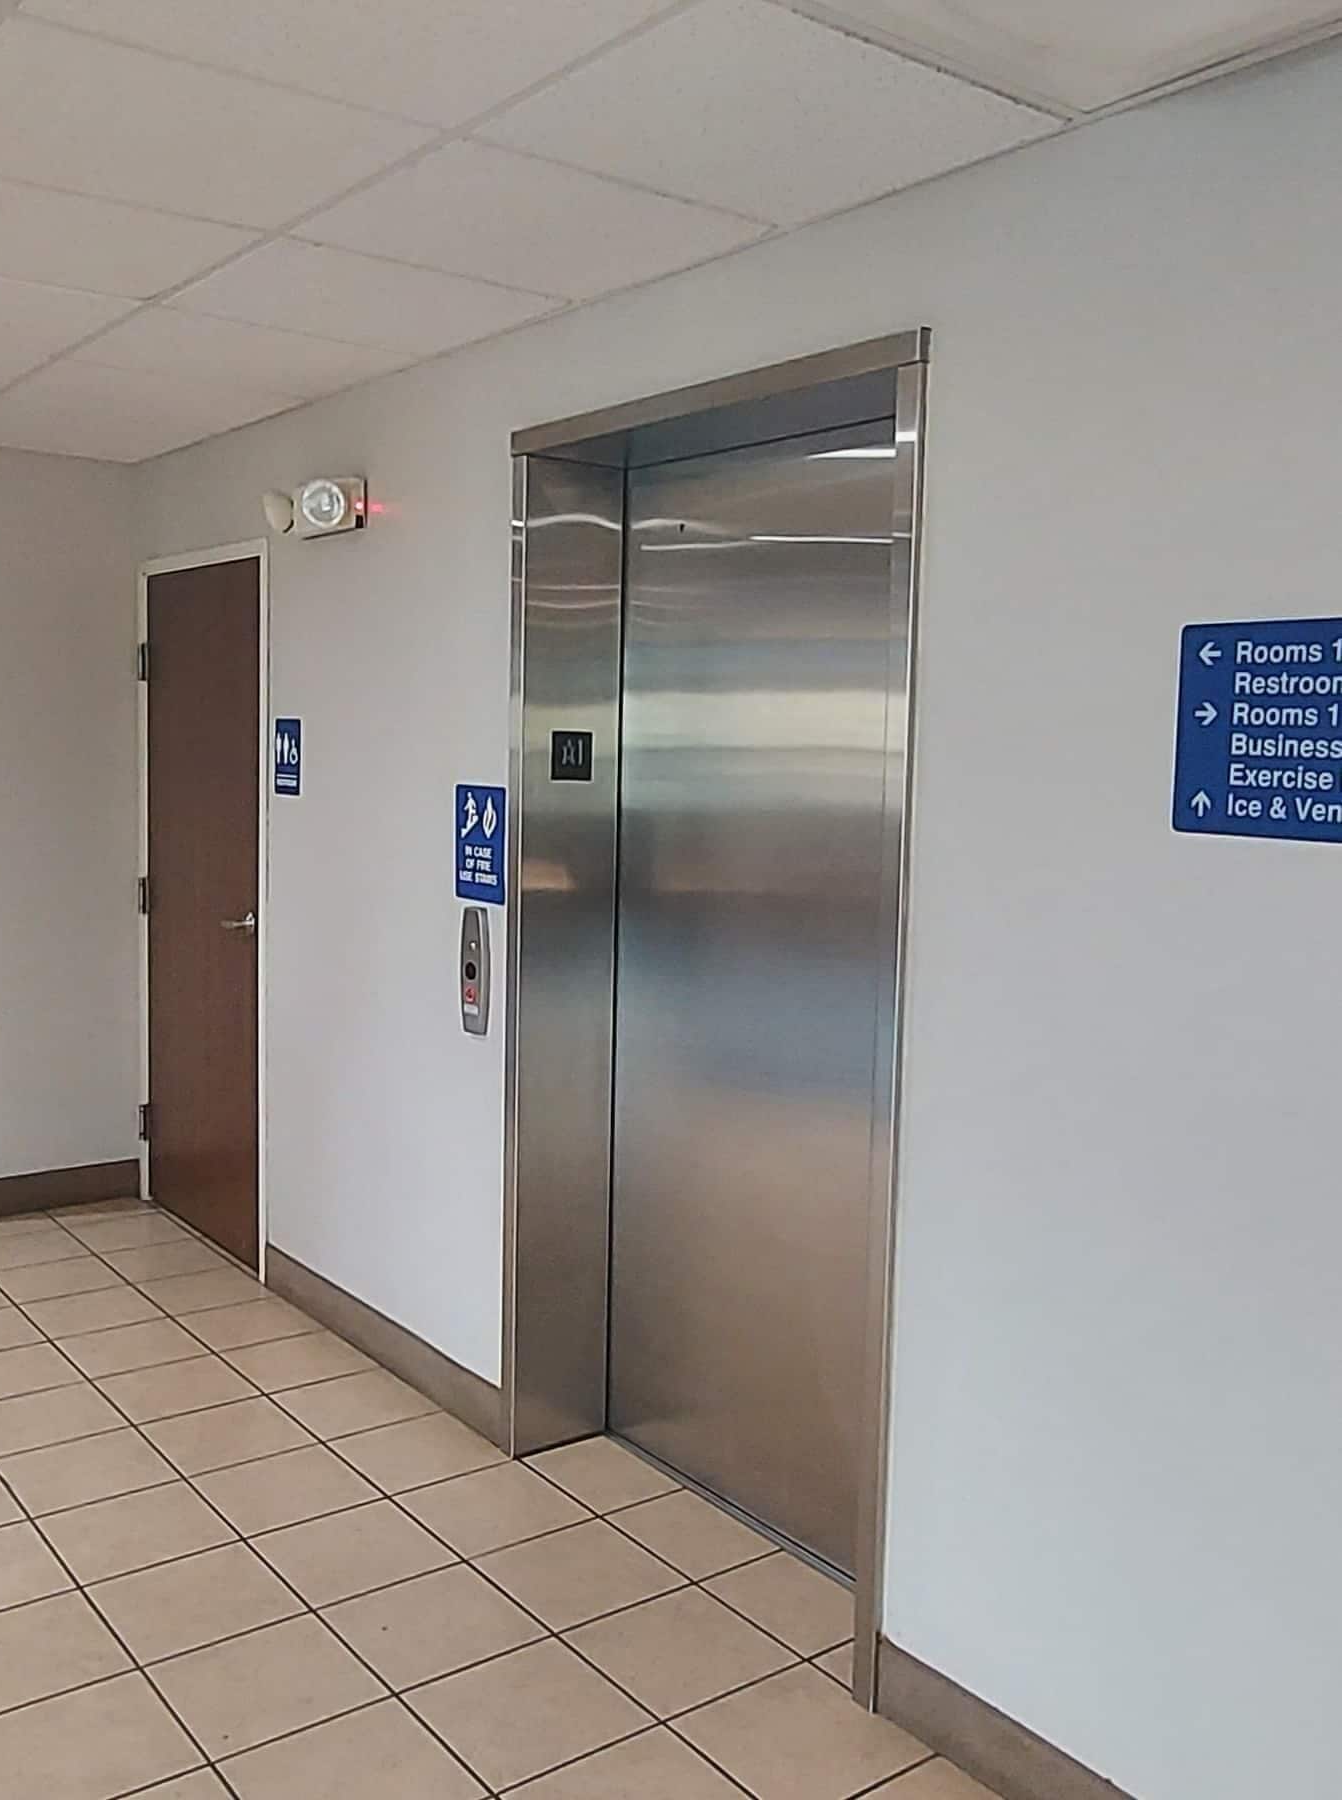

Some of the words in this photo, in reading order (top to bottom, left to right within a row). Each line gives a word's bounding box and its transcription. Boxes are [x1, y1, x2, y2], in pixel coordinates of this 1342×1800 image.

[1235, 640, 1323, 664] Rooms
[1232, 702, 1319, 726] Rooms
[1328, 702, 1340, 727] 1
[1230, 733, 1342, 759] Business
[1228, 763, 1334, 790] Exercise
[1226, 793, 1262, 817] Ice
[1269, 796, 1287, 820] &
[1295, 797, 1342, 823] Ven
